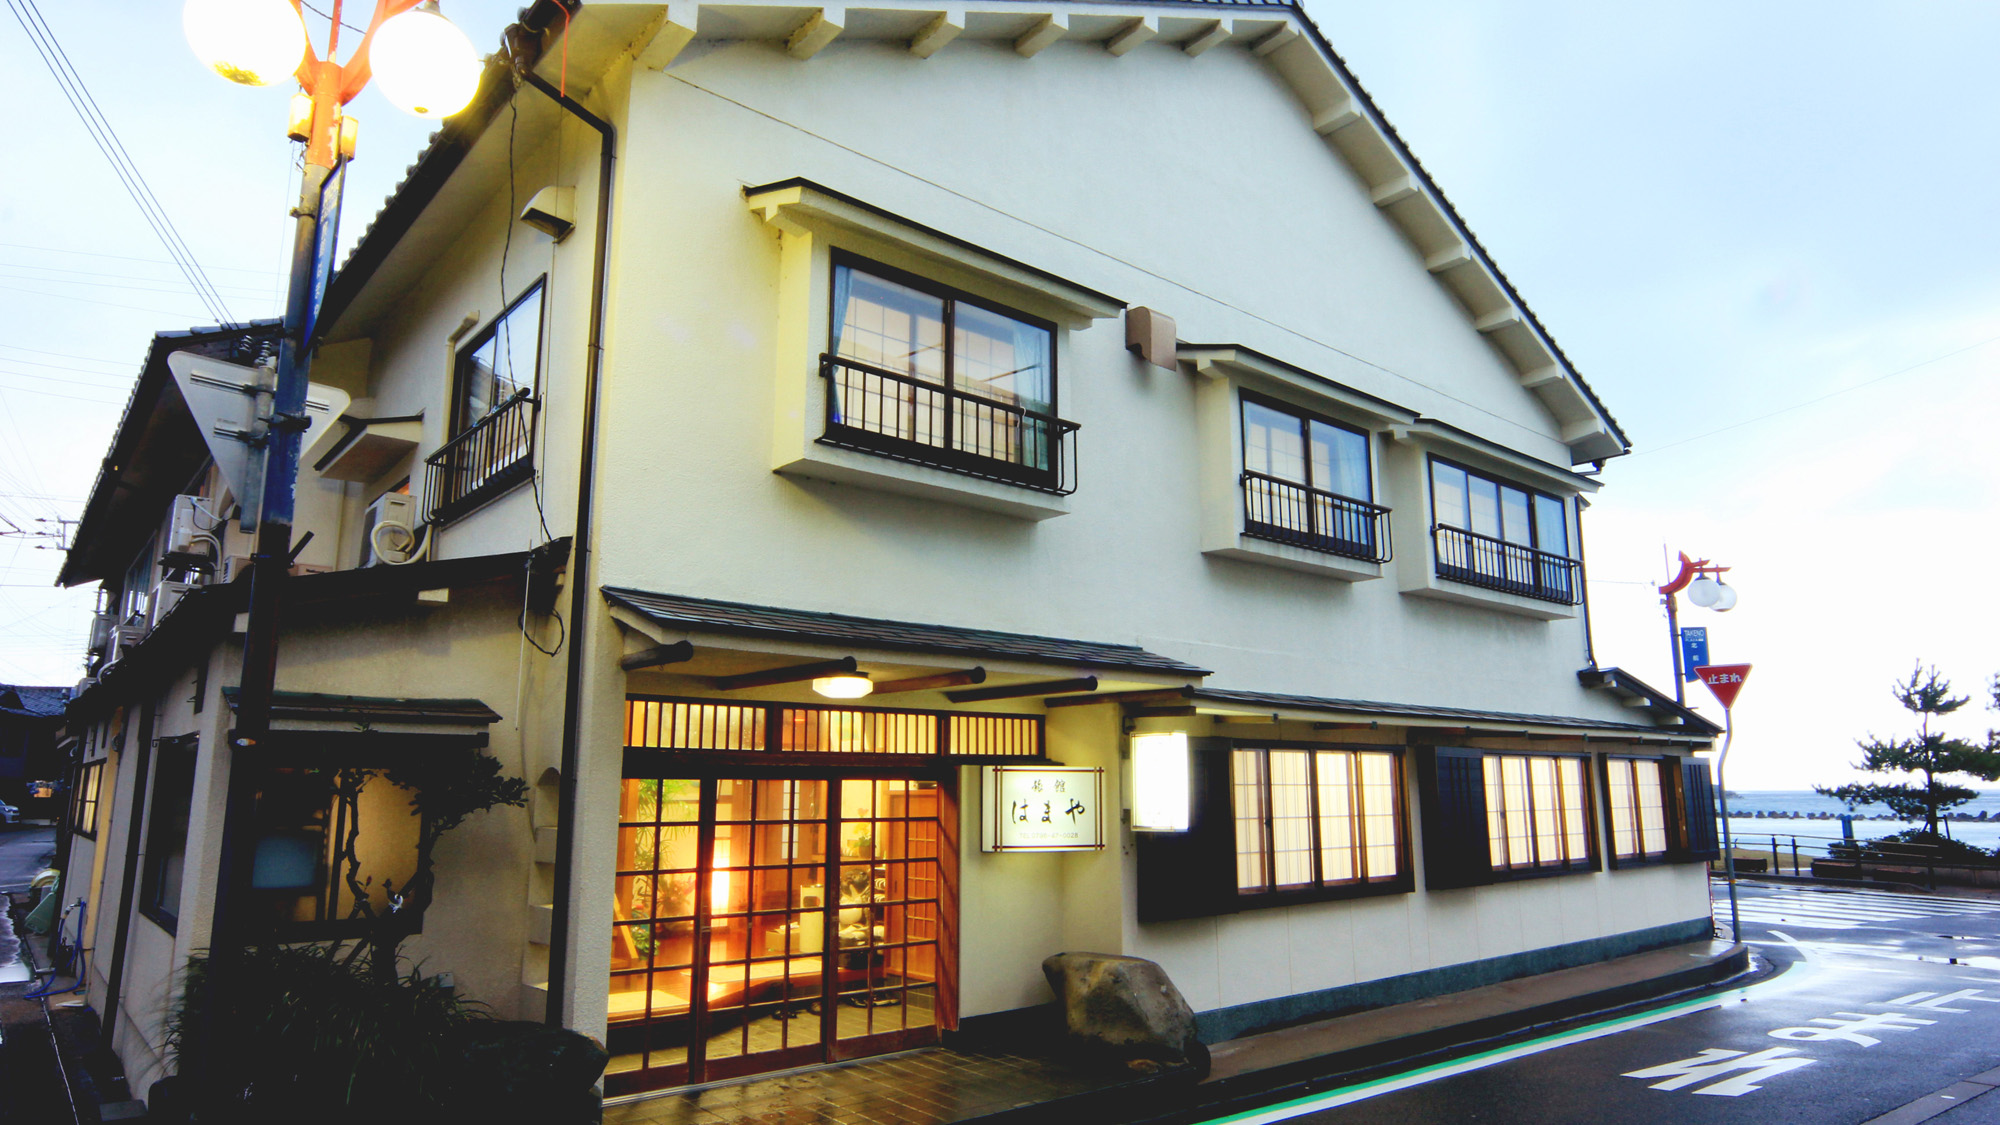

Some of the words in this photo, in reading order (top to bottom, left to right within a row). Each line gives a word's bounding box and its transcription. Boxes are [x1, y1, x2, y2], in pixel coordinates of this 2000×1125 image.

[1708, 673, 1742, 684] 止まれ
[1012, 798, 1085, 825] はまや
